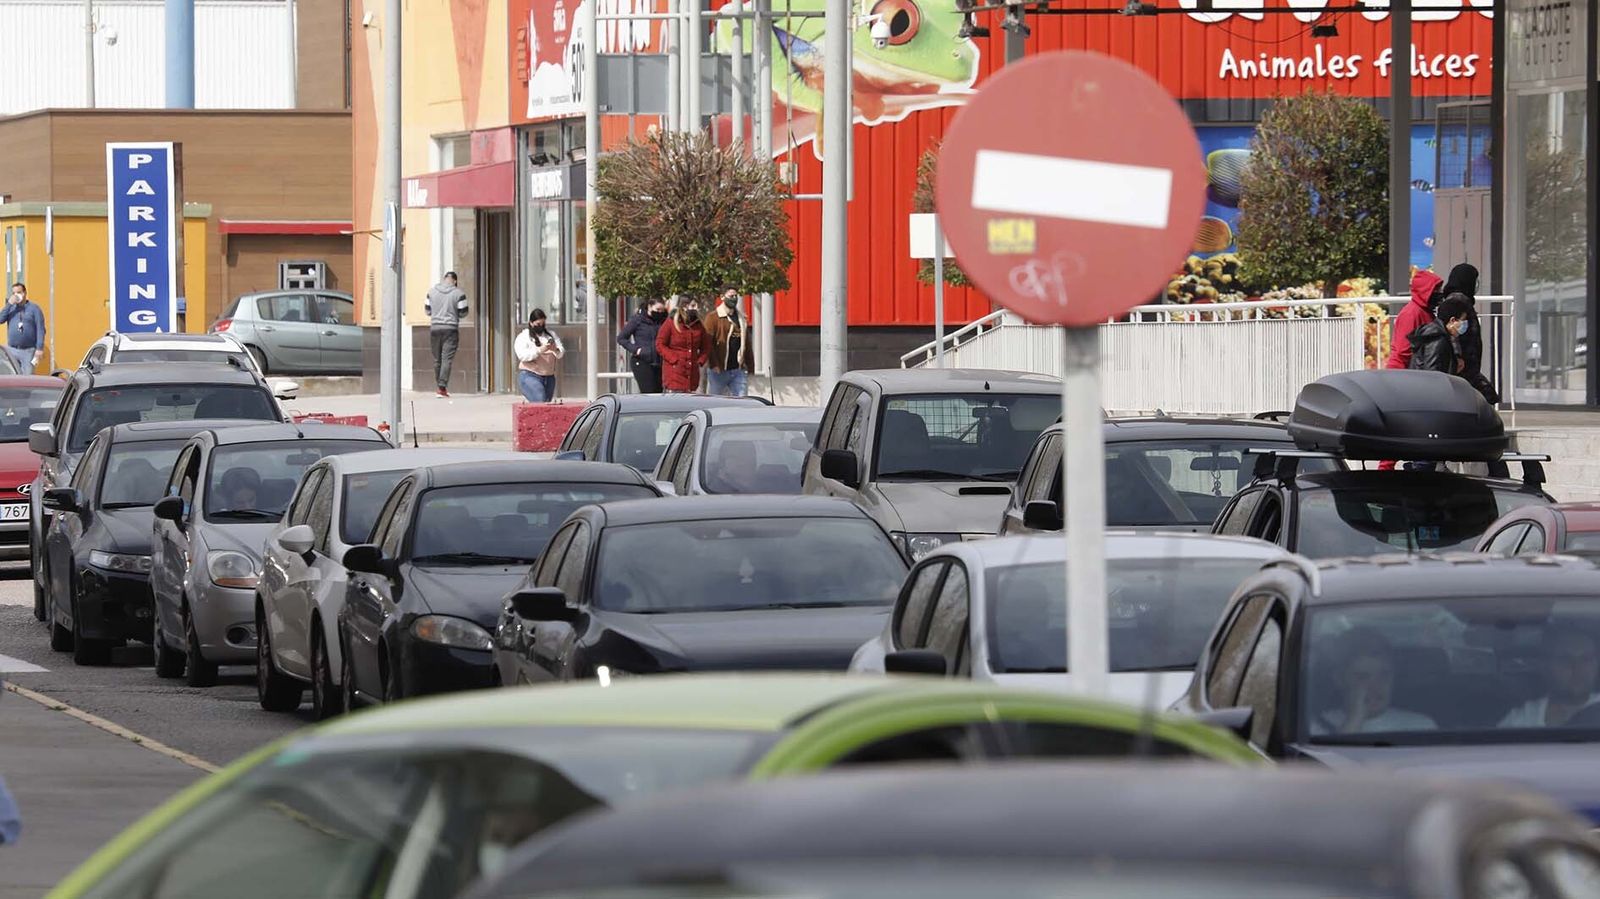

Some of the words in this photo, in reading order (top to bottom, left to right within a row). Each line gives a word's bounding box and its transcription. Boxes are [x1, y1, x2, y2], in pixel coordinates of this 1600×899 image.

[1525, 2, 1570, 39] LACOSTE
[1219, 43, 1362, 79] Animales
[1373, 43, 1480, 78] flices
[1525, 41, 1570, 66] OUTLET
[126, 154, 157, 325] PARKING
[5, 506, 28, 518] 767
